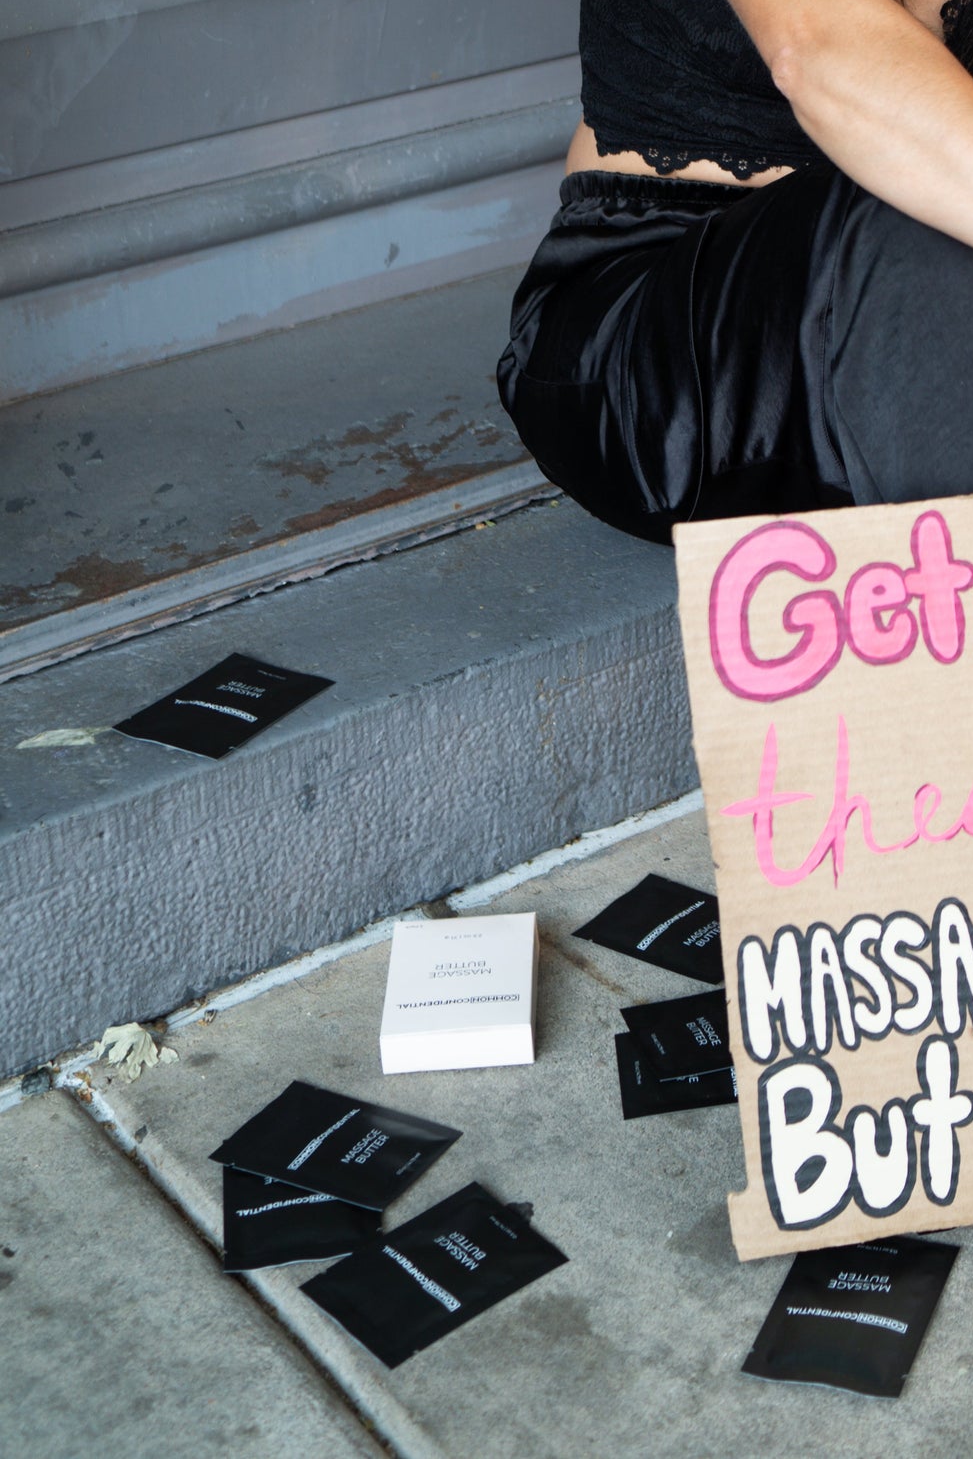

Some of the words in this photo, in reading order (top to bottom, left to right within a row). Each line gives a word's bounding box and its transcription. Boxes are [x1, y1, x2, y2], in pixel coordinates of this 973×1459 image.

[695, 927, 721, 948] BUTTE
[428, 968, 493, 980] MASSAGE
[435, 960, 487, 971] BUTTER
[340, 1128, 382, 1164] MASSAGE
[354, 1134, 390, 1164] BUTTER
[433, 1235, 479, 1271] MASSAGE
[449, 1231, 487, 1261] BUTTER
[828, 1279, 892, 1293] MASSAGE
[838, 1271, 890, 1283] BUTTER
